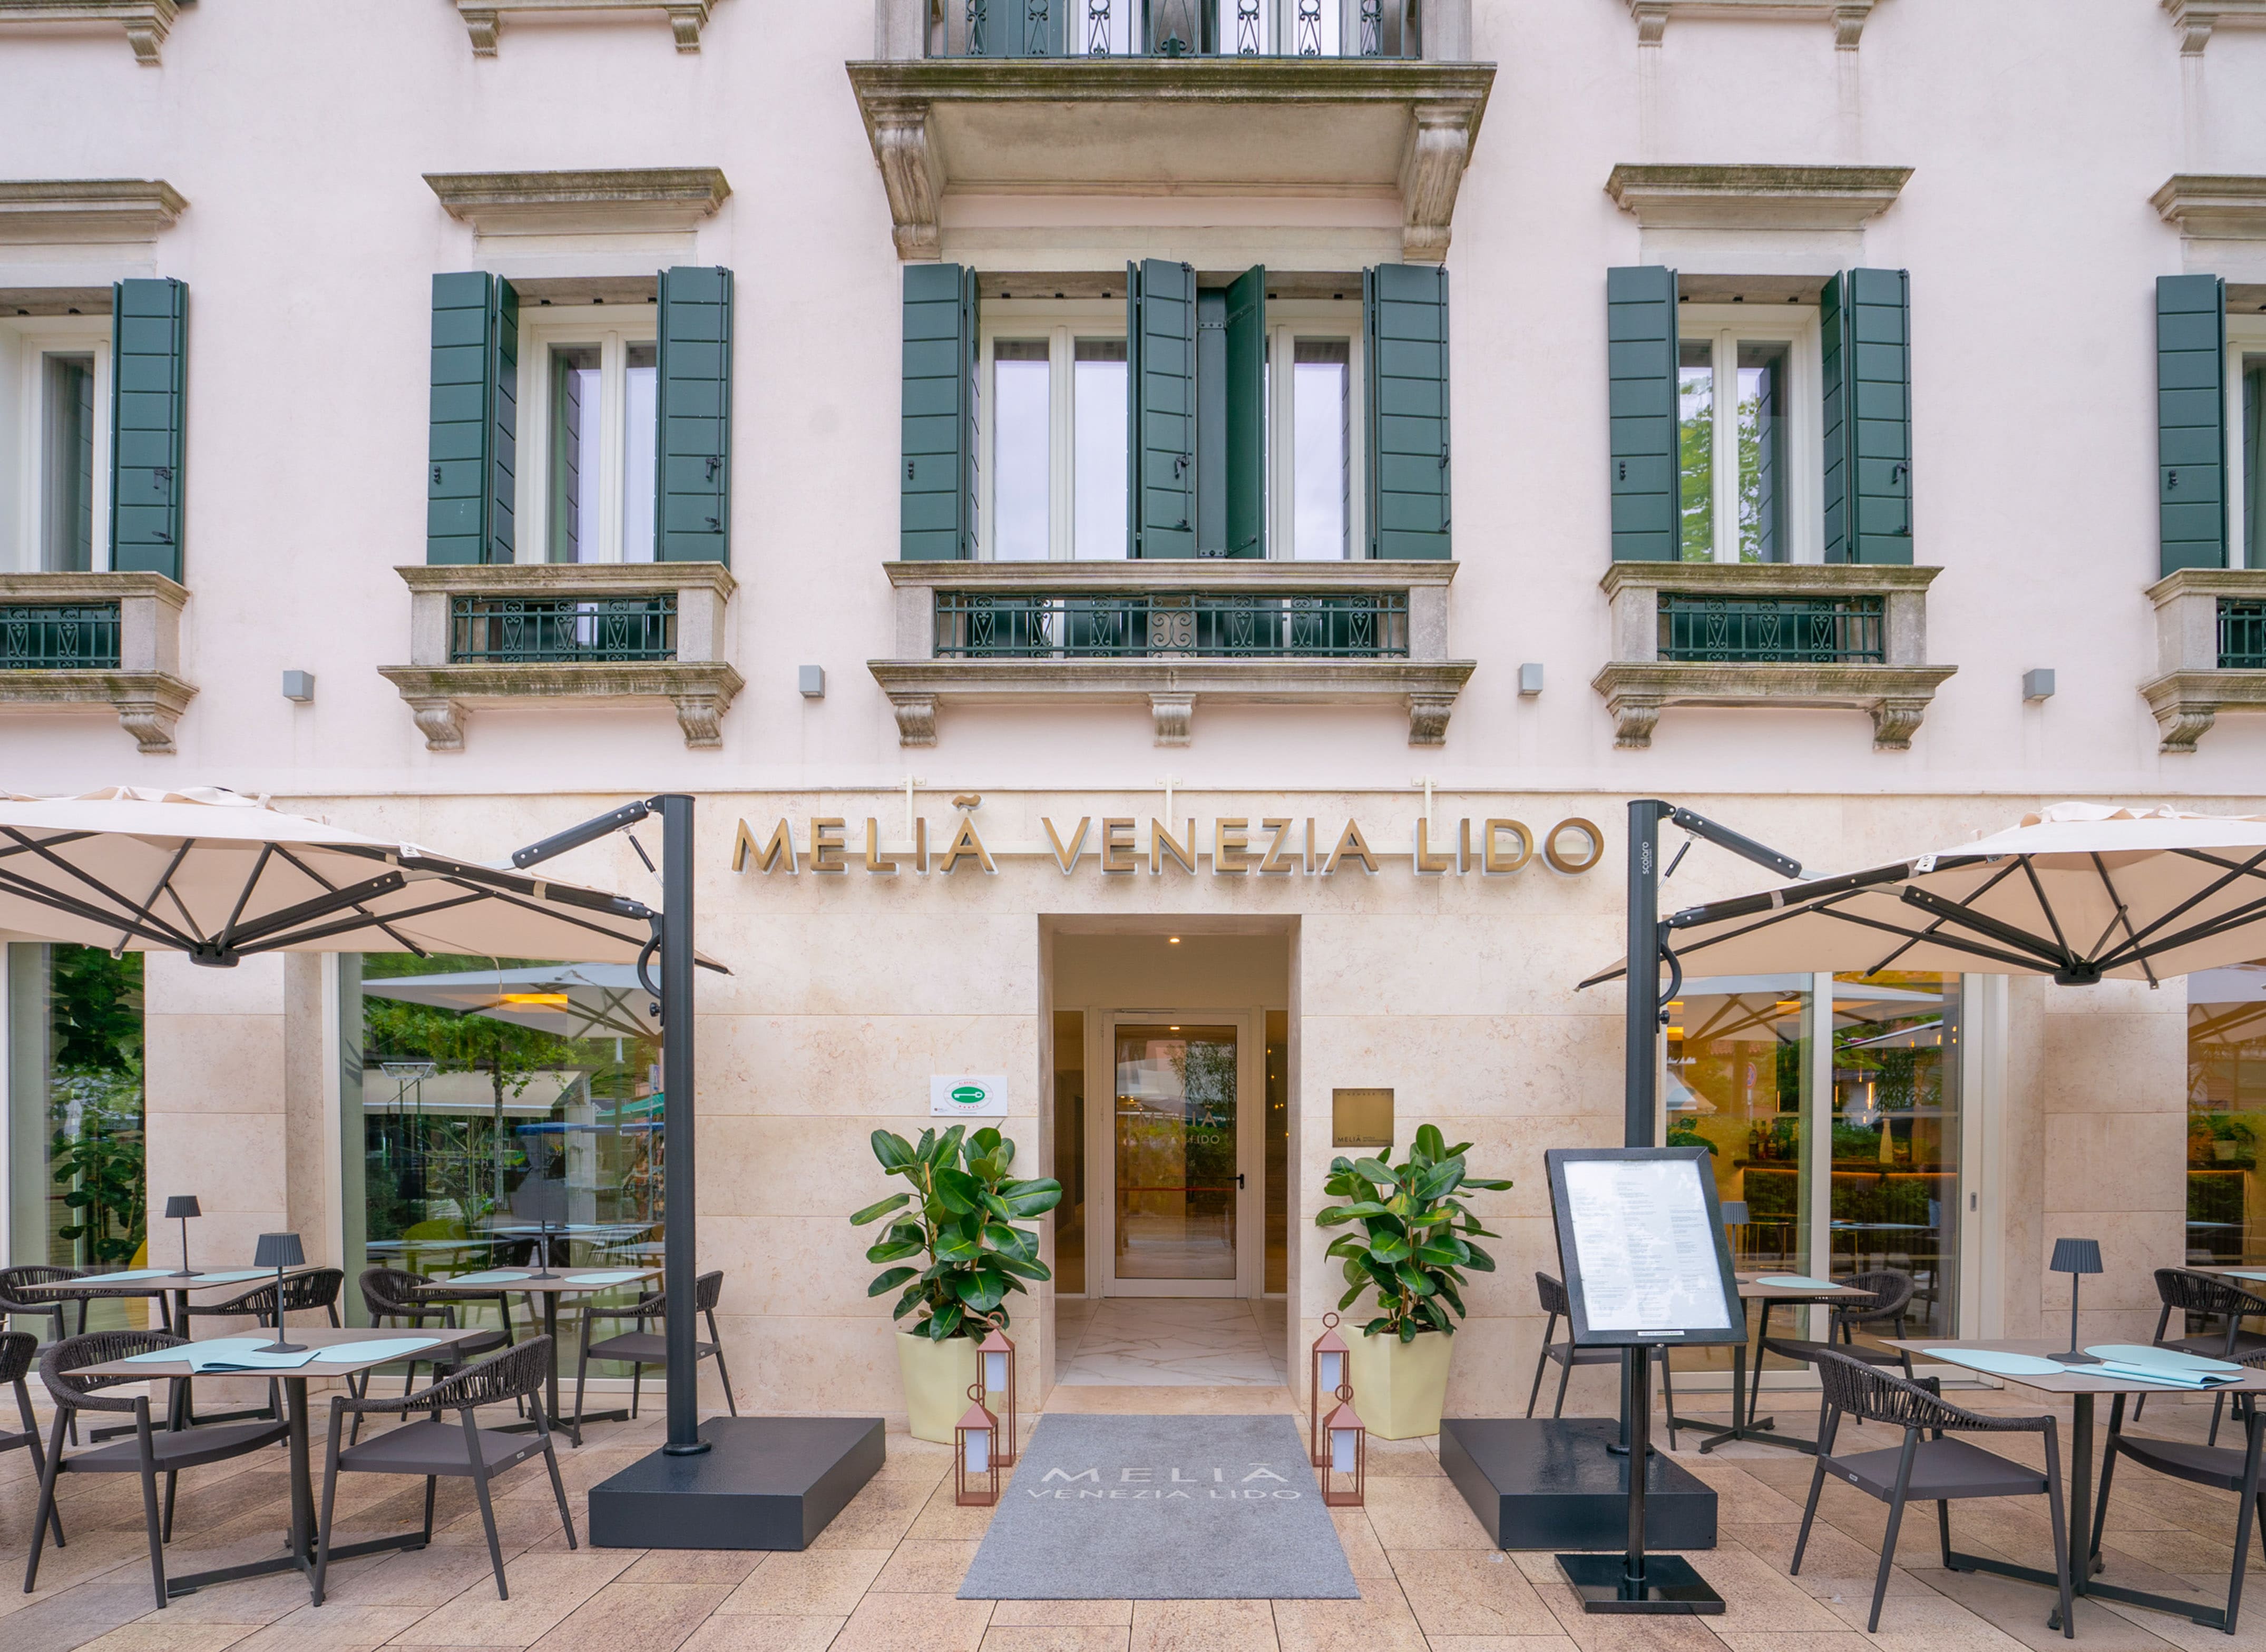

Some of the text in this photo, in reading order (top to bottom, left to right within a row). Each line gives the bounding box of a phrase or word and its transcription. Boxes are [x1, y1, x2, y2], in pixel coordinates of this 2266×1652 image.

[1041, 816, 1379, 875] VENEZIA
[1414, 817, 1604, 876] LIDO
[1640, 842, 1649, 874] scolaro
[1028, 1490, 1301, 1499] VENEZIA LIDO
